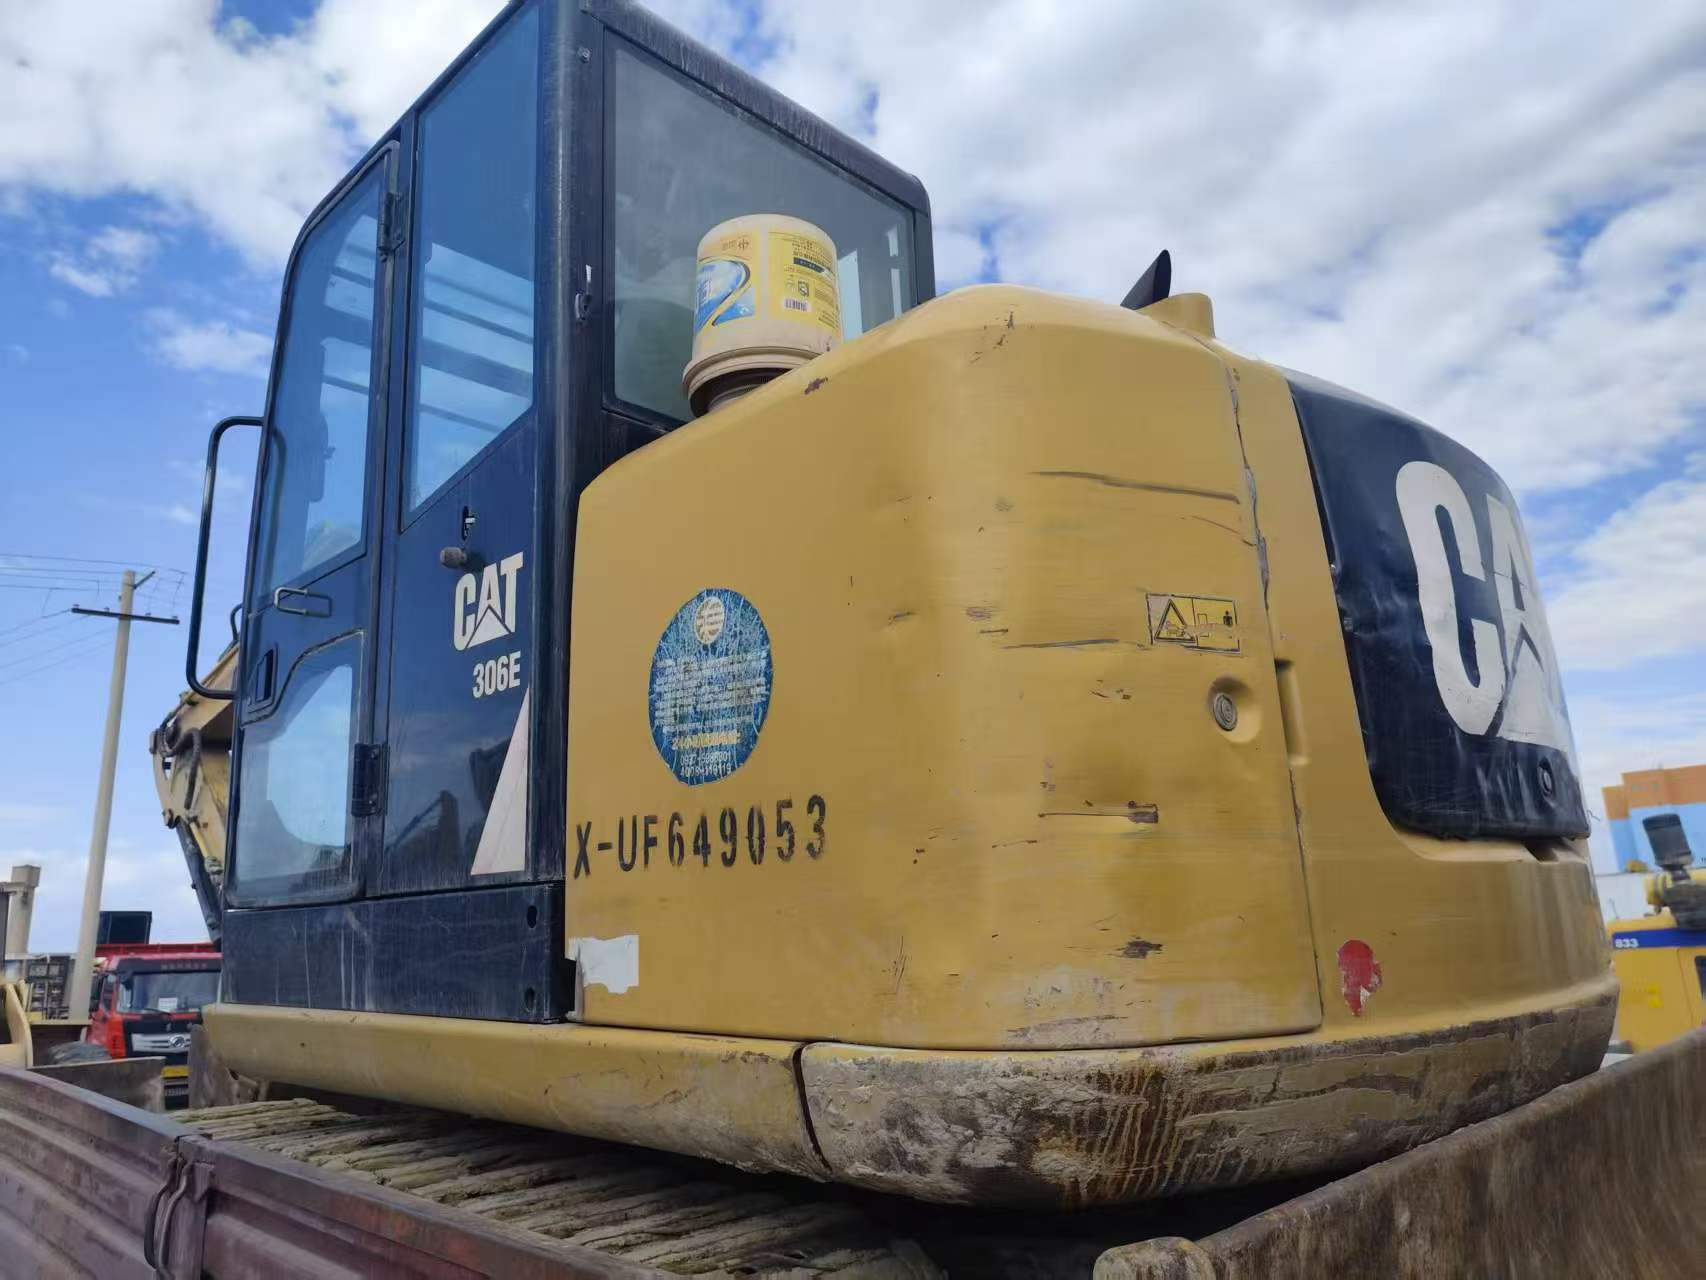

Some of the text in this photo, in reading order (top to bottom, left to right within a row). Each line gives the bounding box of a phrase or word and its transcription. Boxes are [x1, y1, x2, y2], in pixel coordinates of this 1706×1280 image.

[453, 551, 524, 651] CAT
[1396, 460, 1566, 754] CA
[472, 650, 522, 699] 306E
[573, 794, 827, 880] X-UF649053
